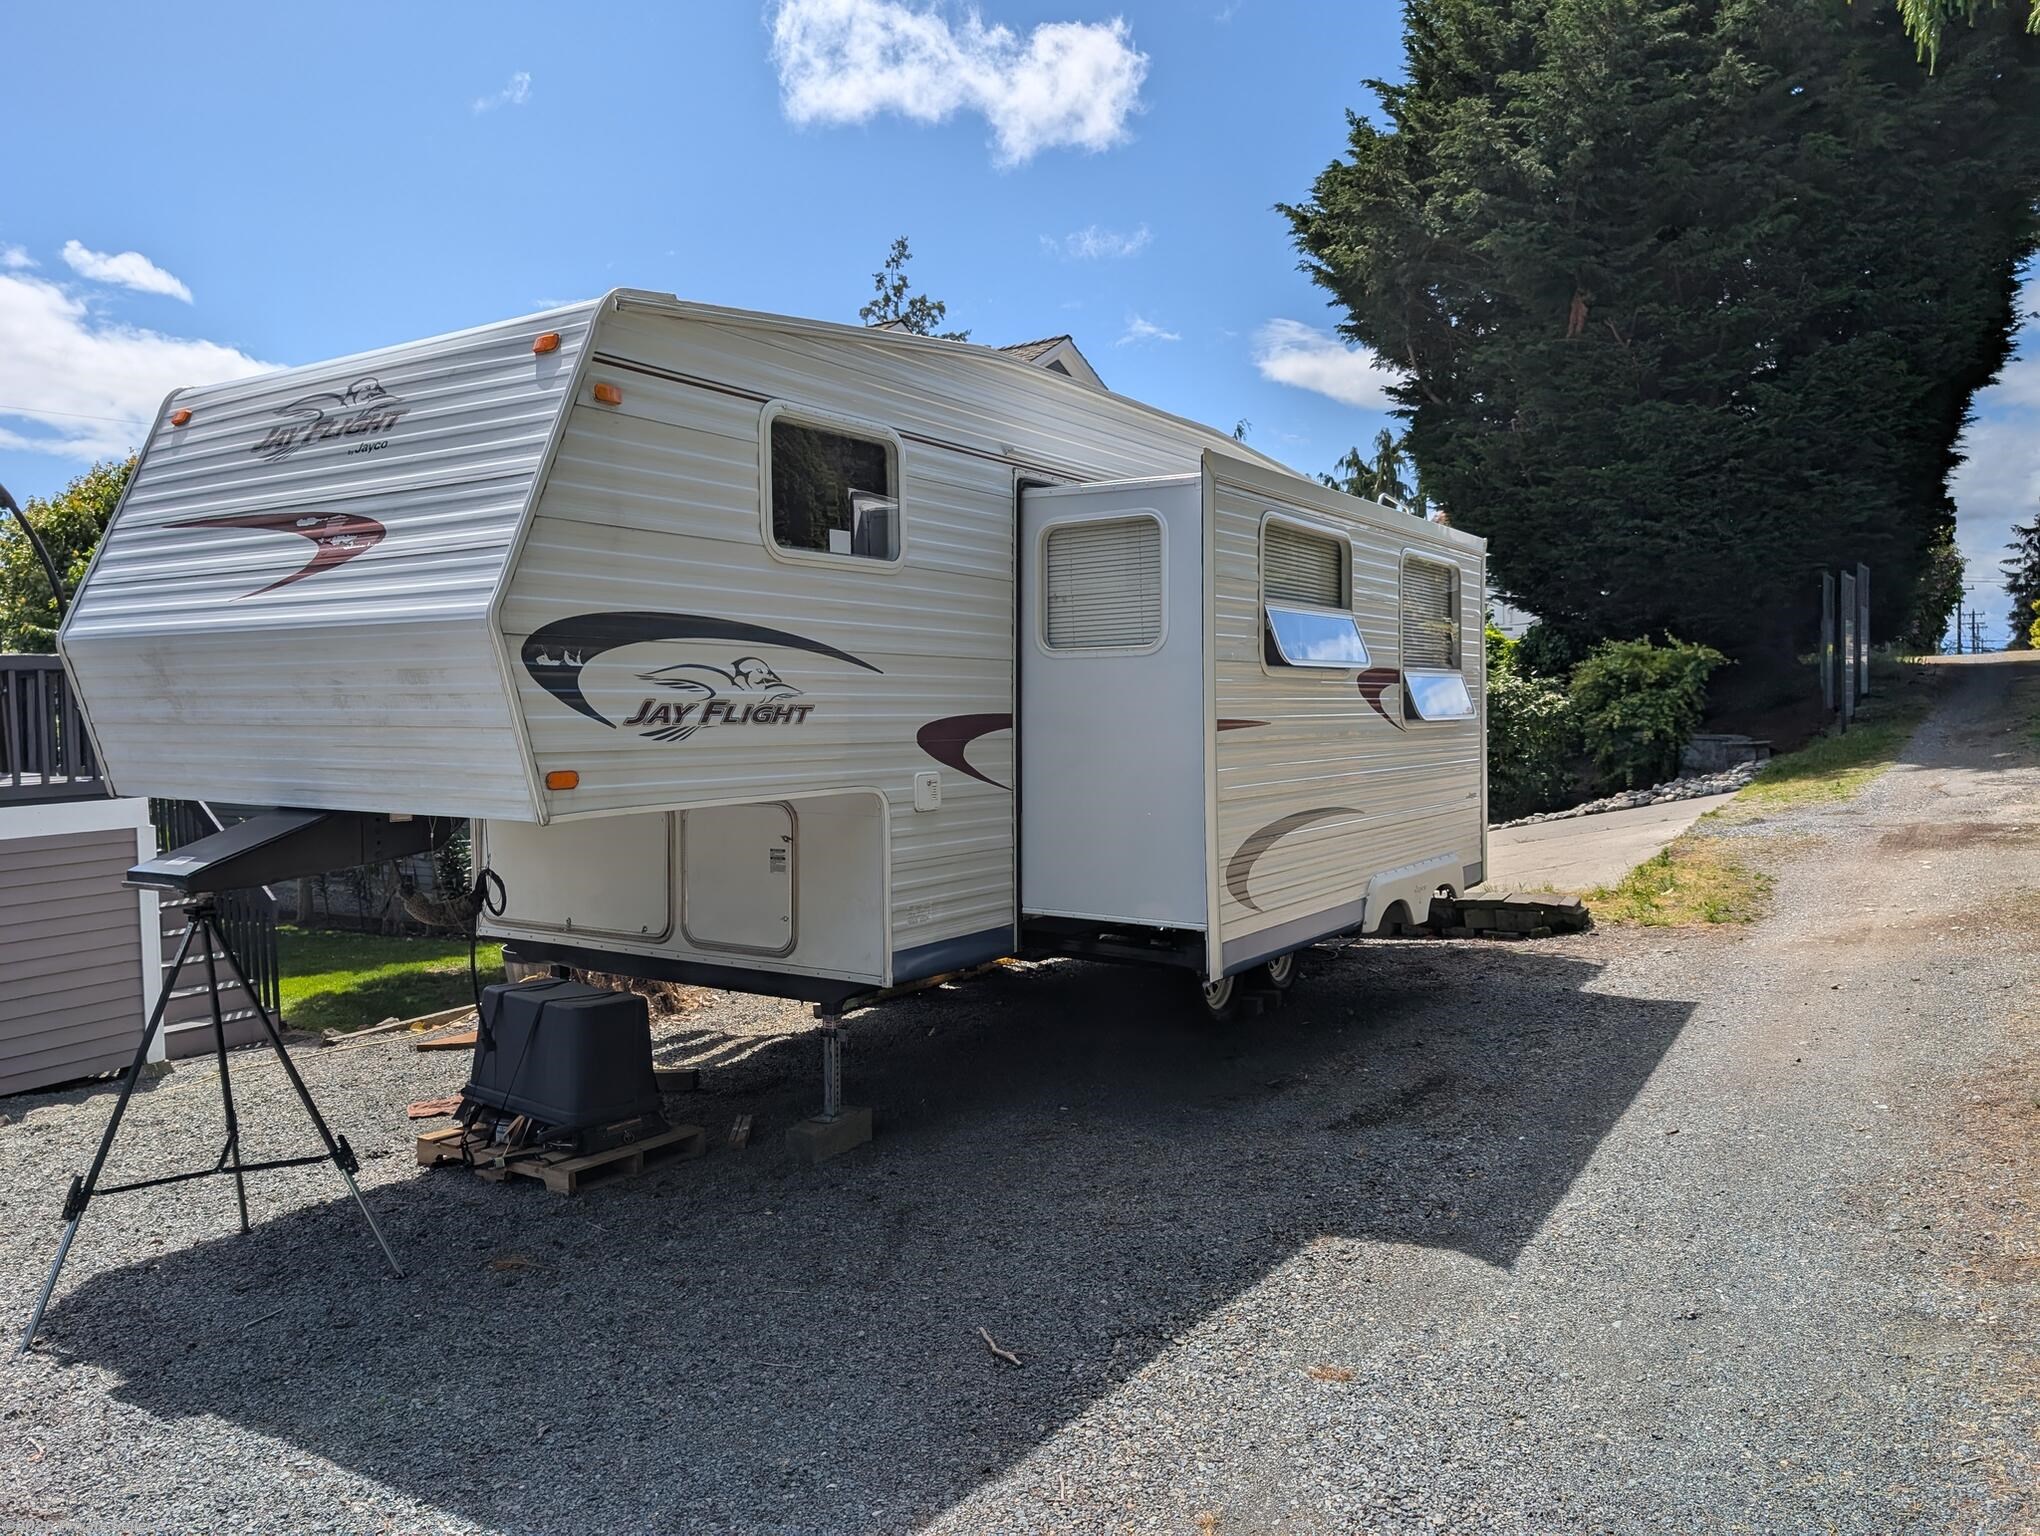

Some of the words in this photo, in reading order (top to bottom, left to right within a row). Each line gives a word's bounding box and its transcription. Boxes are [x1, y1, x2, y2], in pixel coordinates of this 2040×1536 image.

[251, 425, 309, 452] JAY
[301, 408, 411, 443] FLIGHT
[354, 440, 388, 455] Jayco
[623, 698, 699, 726] JAY
[698, 699, 815, 726] FLIGHT
